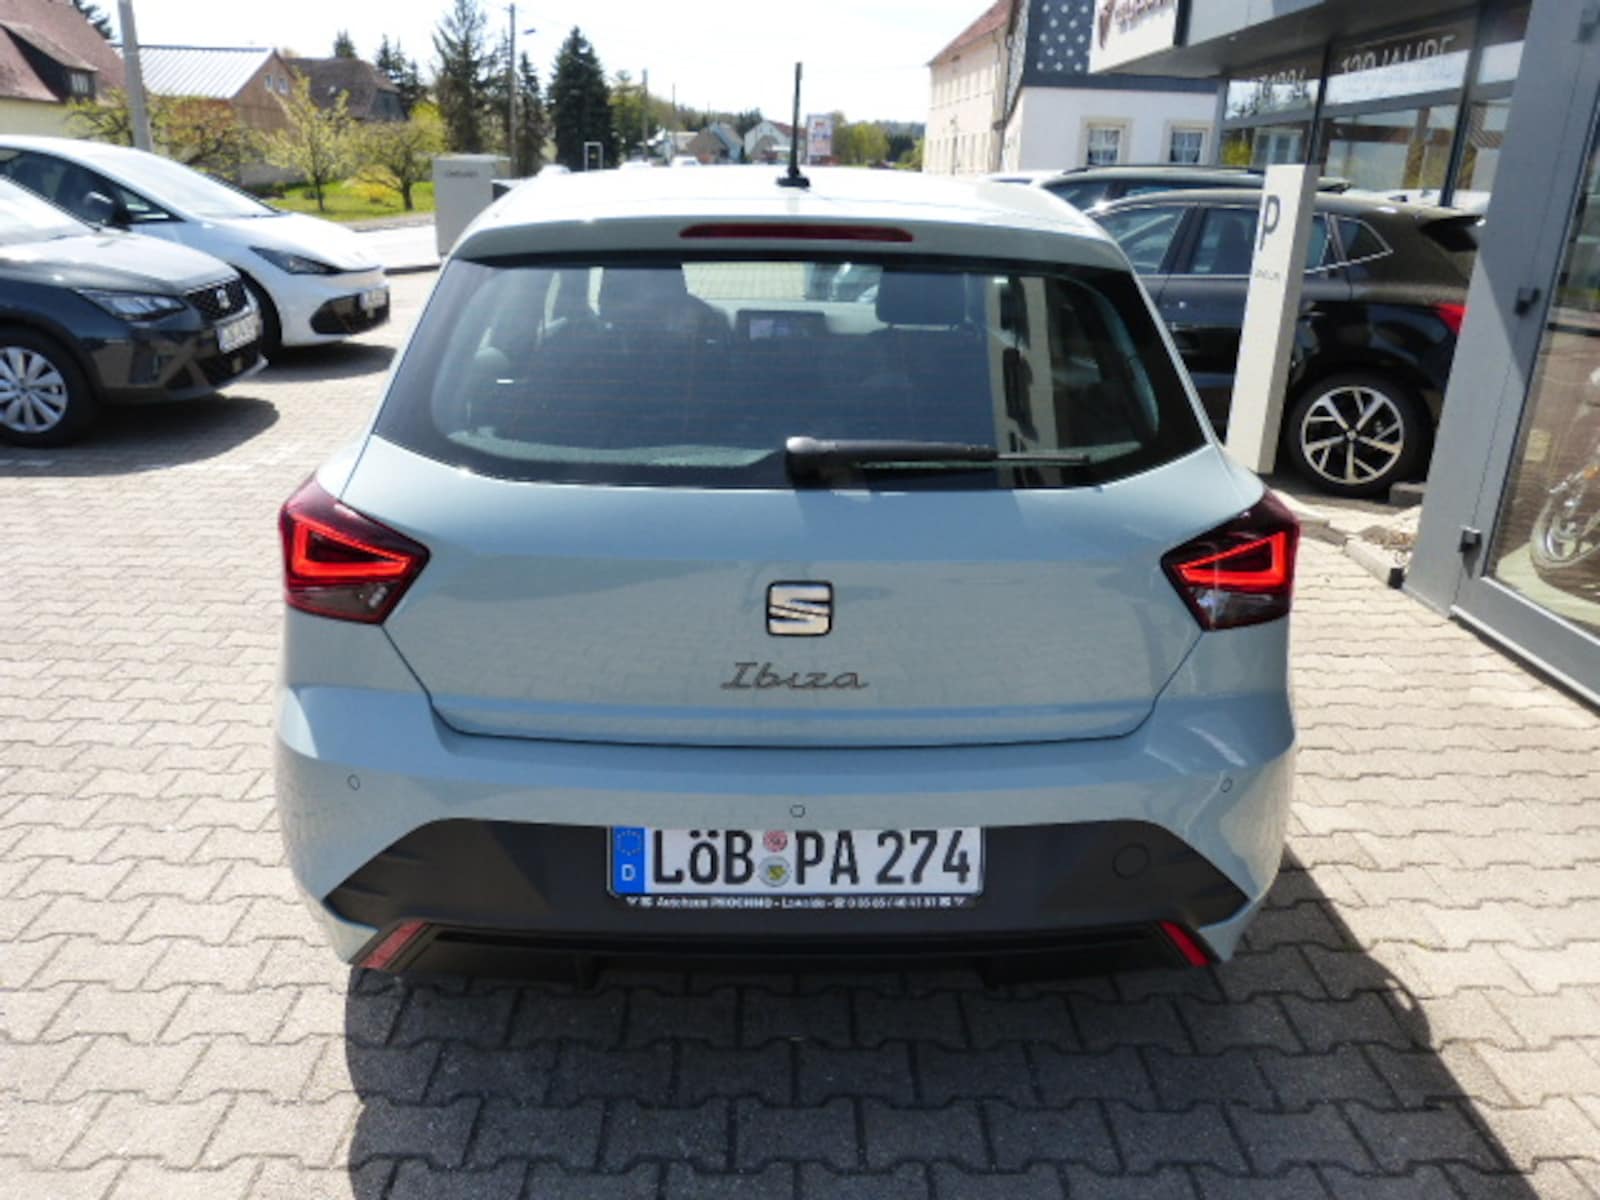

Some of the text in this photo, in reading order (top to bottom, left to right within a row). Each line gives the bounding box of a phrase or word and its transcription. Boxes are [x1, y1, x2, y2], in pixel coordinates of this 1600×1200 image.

[721, 661, 869, 689] Ibiza
[653, 829, 971, 885] LÖB PA 274
[621, 863, 636, 881] D
